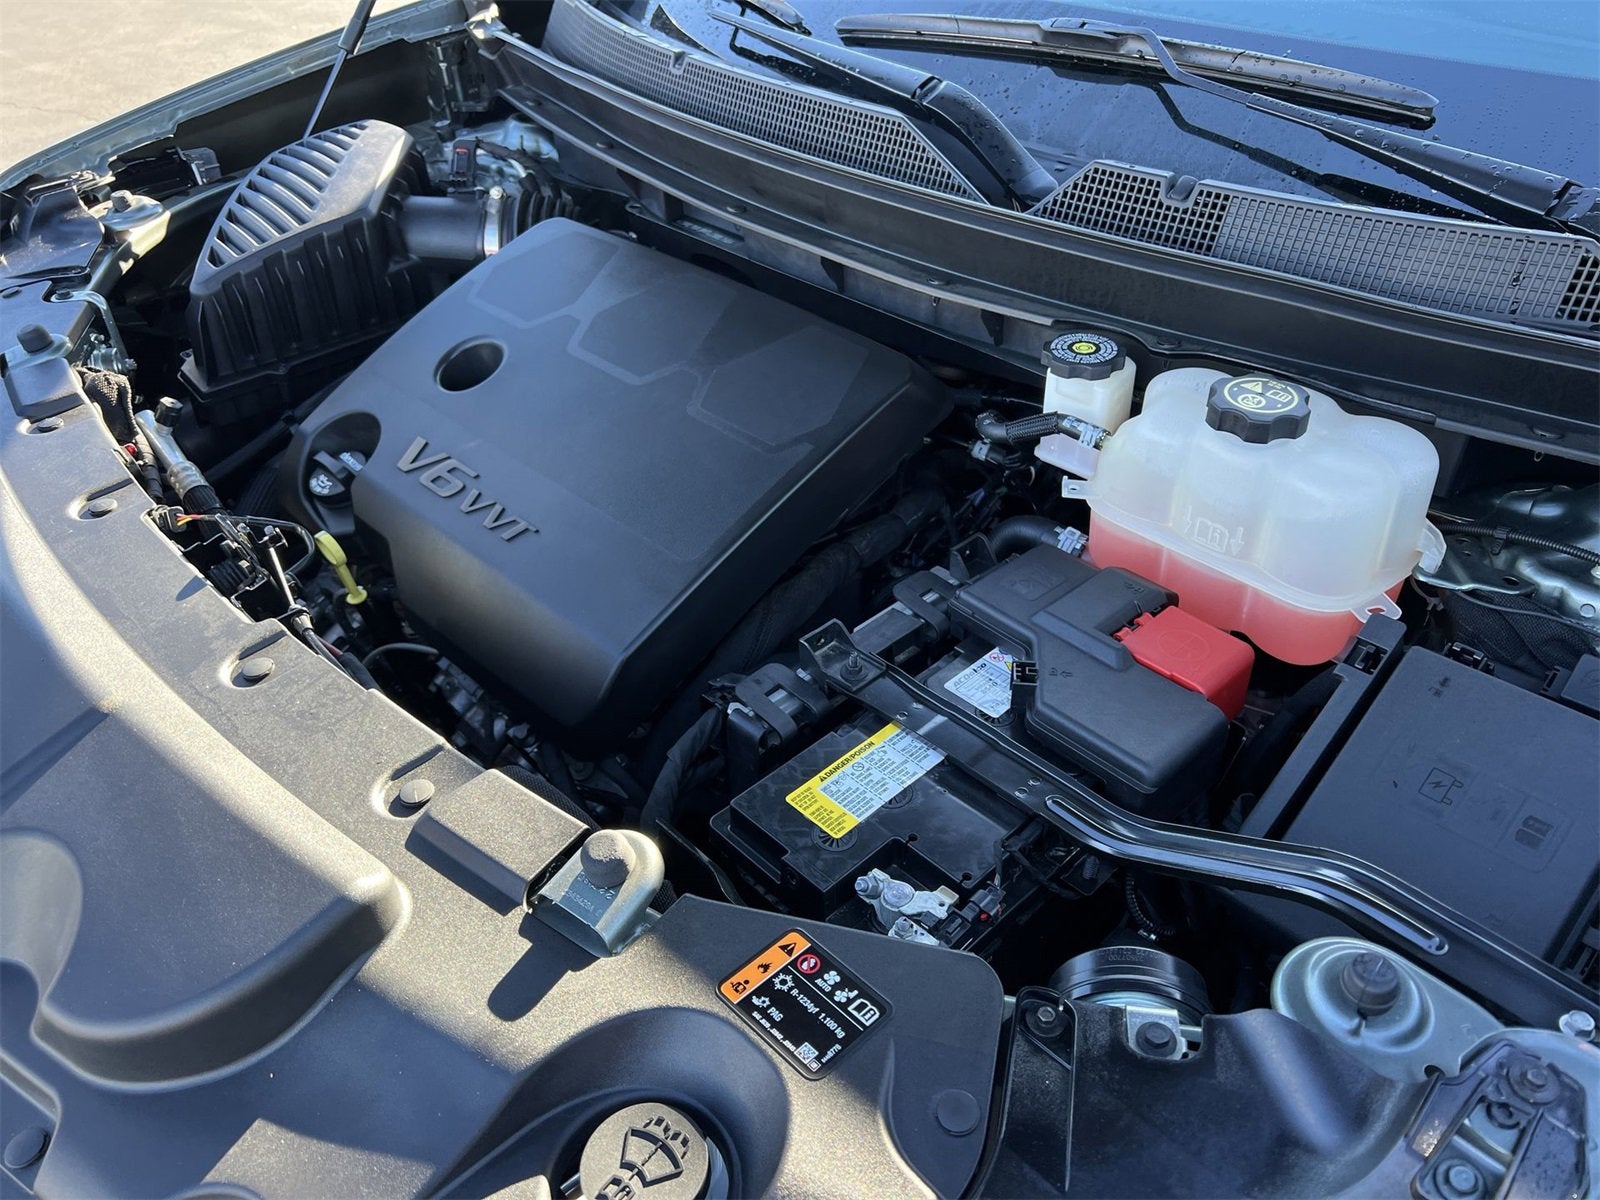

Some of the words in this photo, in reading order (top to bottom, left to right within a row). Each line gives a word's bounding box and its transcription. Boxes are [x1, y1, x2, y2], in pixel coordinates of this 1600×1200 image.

[397, 436, 479, 498] V6
[460, 488, 539, 542] VVT
[825, 740, 876, 778] DANGER/POISON
[814, 978, 832, 993] AUTO
[767, 1006, 784, 1022] PAG
[790, 988, 820, 1014] R-1234yf
[818, 1013, 838, 1031] 1.100
[834, 1026, 846, 1039] kg
